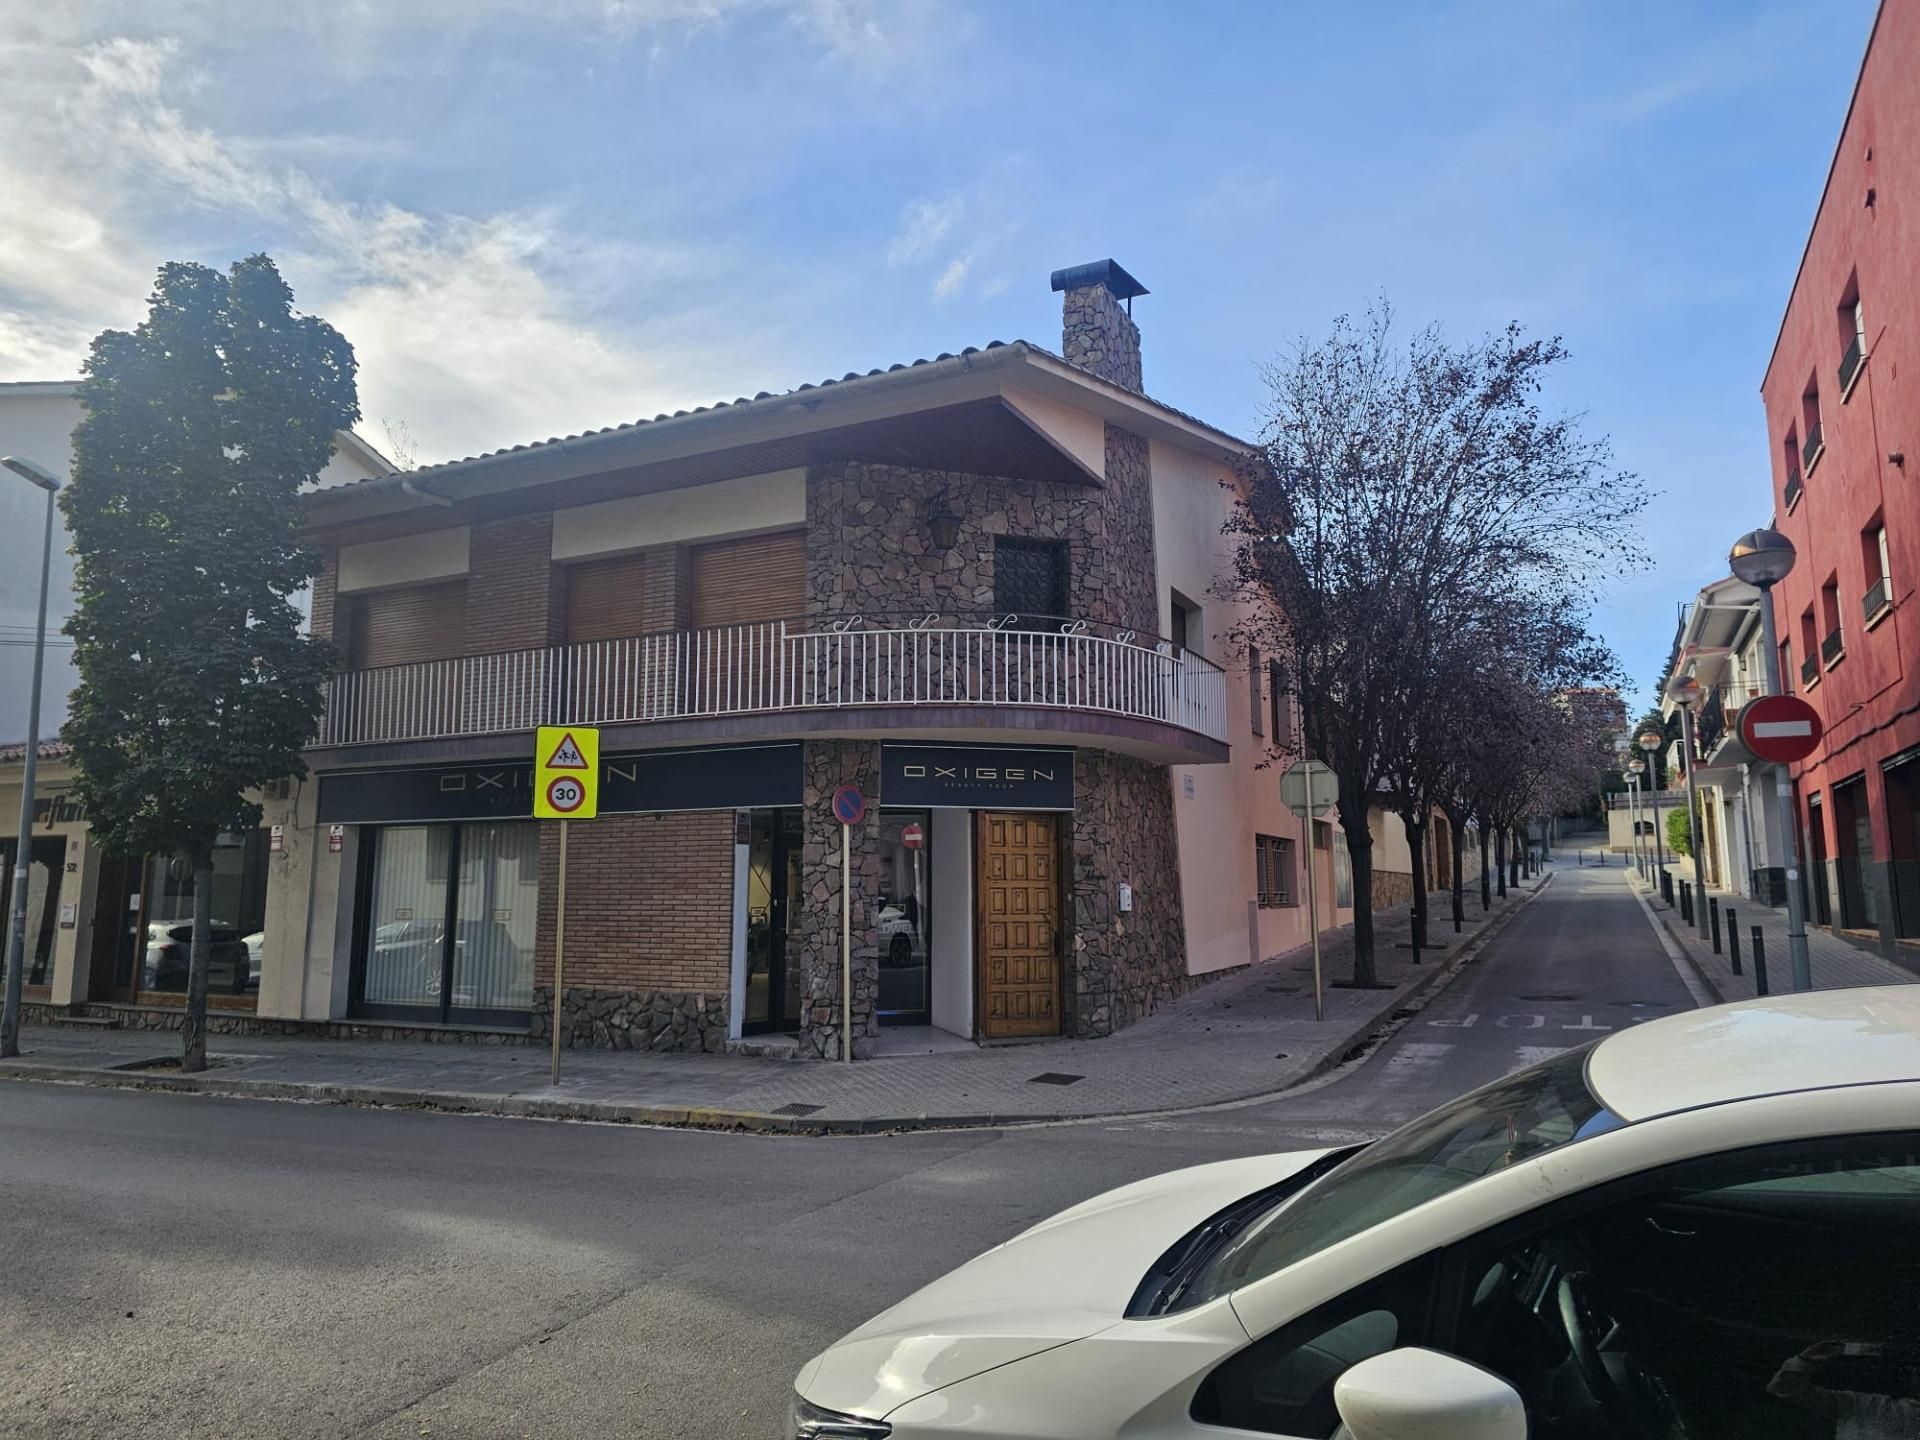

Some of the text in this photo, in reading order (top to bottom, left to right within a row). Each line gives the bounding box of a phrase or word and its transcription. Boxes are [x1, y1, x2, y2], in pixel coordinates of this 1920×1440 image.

[440, 763, 637, 792] OXIN
[903, 764, 1054, 782] OXIGEN
[555, 787, 577, 801] 30
